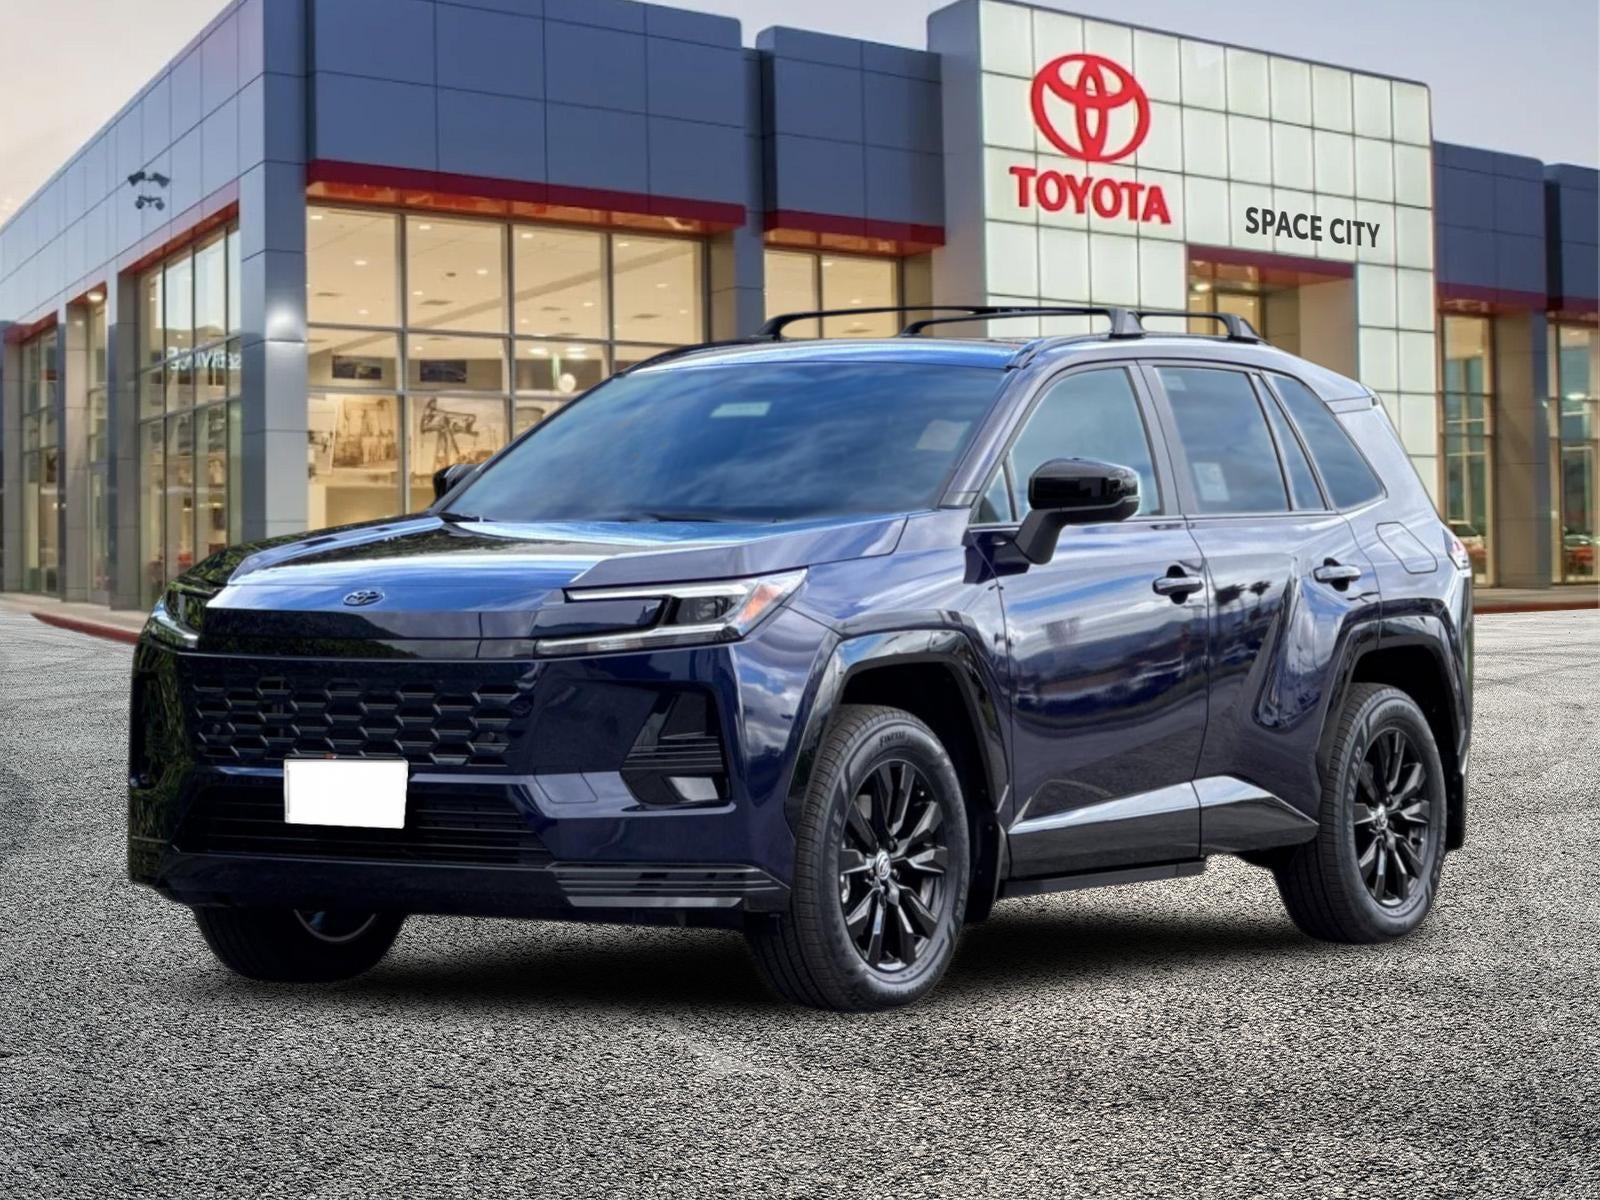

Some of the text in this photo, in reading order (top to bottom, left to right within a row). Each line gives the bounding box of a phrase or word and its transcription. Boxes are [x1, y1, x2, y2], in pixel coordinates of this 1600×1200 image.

[1009, 165, 1171, 224] TOYOTA
[1245, 206, 1381, 248] SPACE CITY
